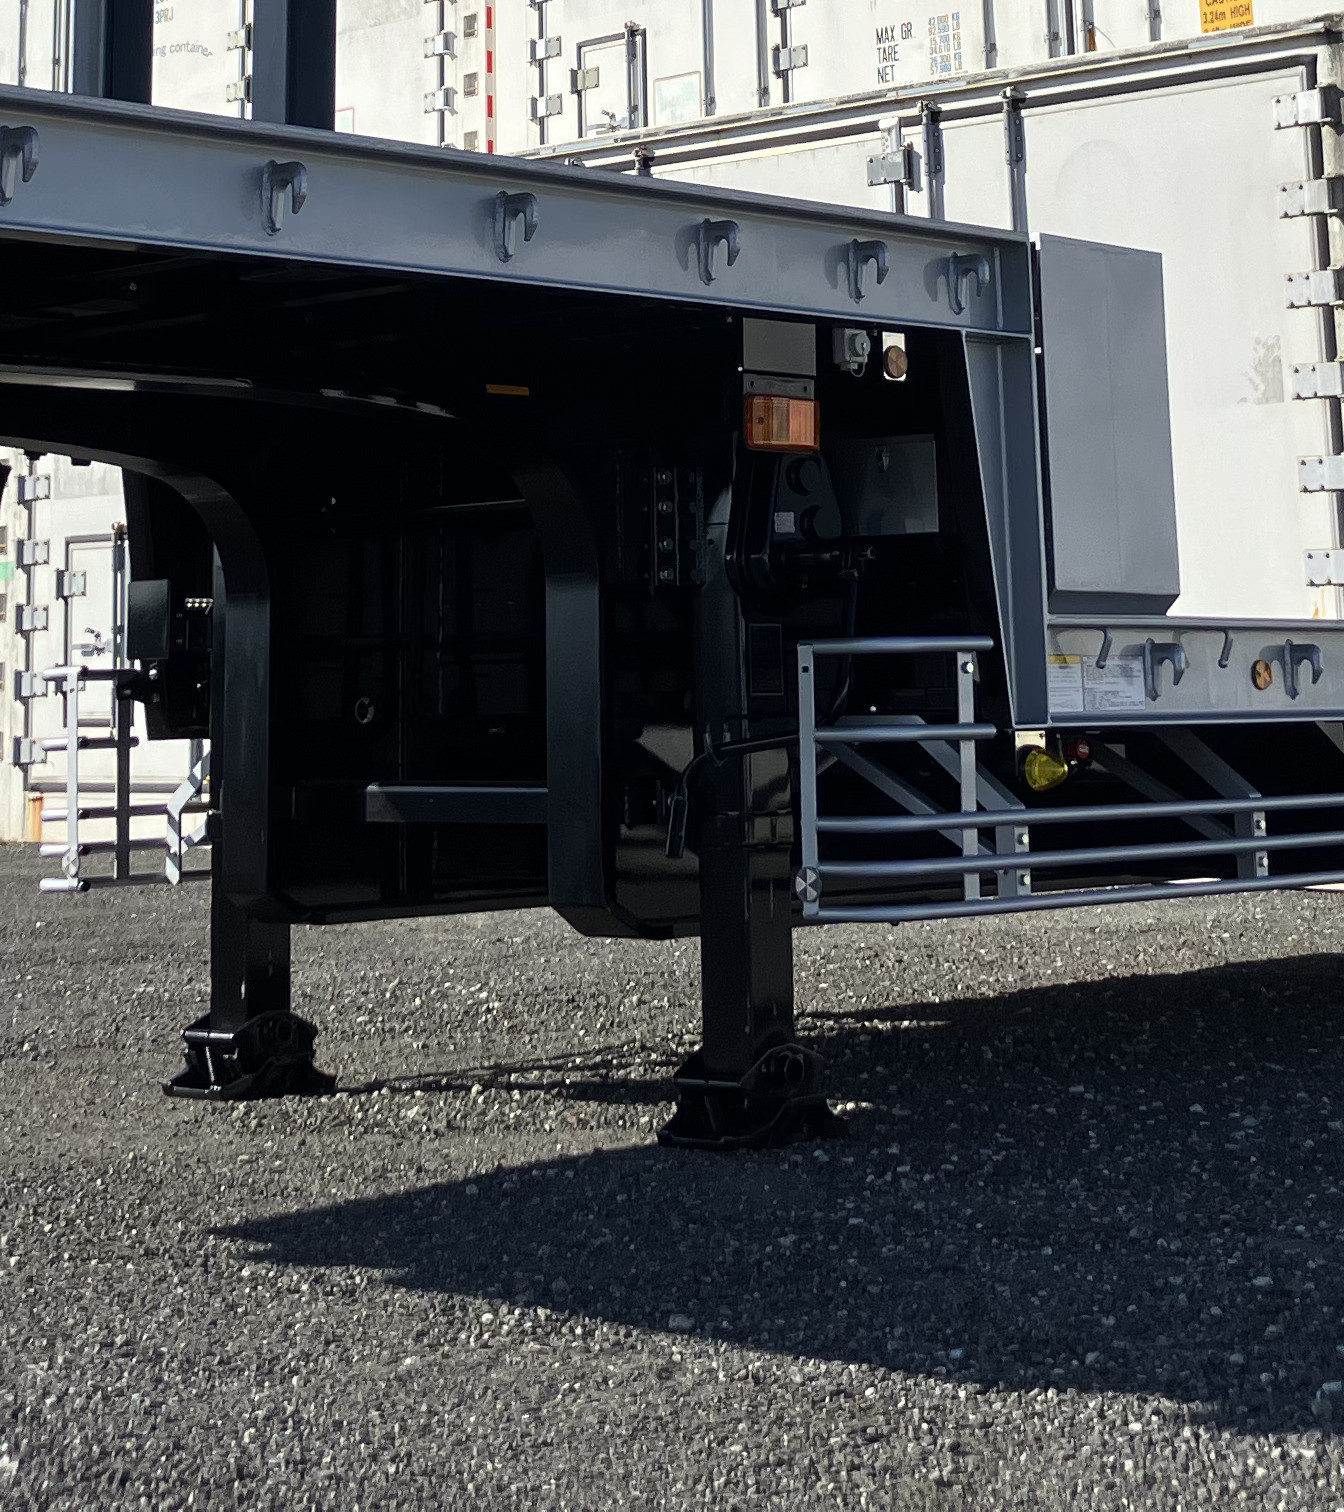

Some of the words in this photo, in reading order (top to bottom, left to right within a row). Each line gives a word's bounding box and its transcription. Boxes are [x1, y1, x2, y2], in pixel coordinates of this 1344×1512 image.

[1230, 3, 1251, 19] HIGH
[877, 44, 899, 64] TARE
[877, 65, 896, 84] NET
